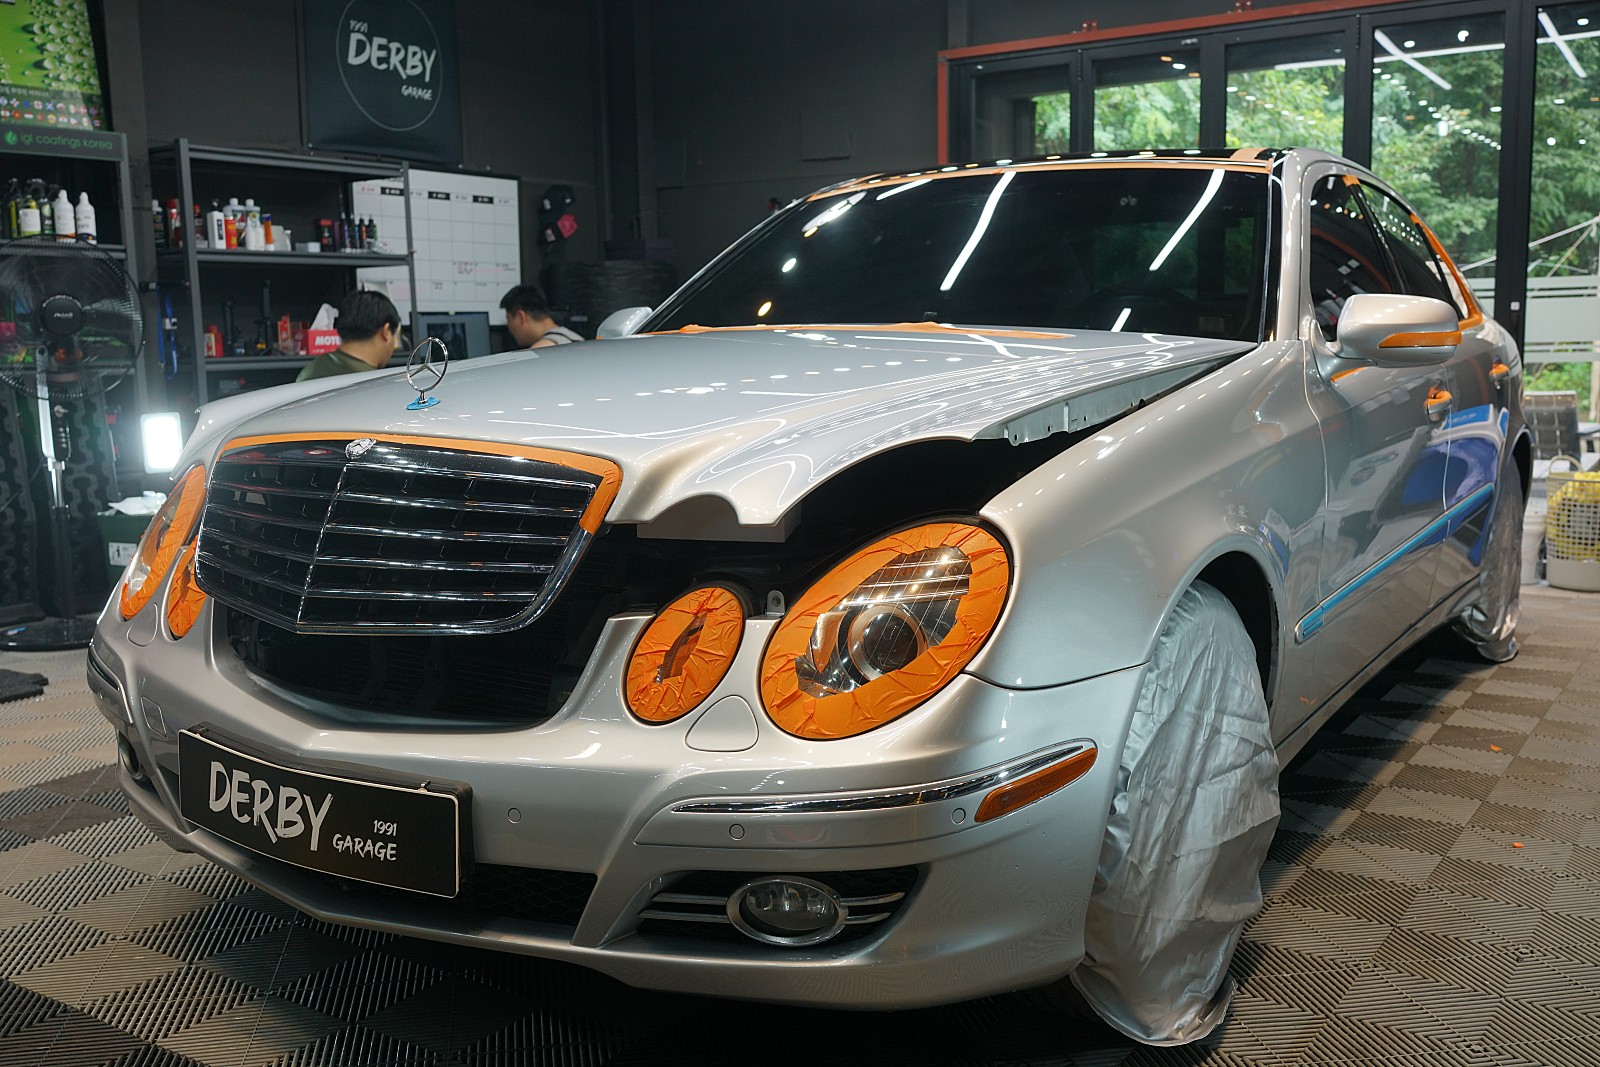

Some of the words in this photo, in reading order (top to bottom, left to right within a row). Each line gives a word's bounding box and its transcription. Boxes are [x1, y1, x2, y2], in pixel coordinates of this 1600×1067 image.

[347, 32, 437, 83] DERBY
[401, 84, 433, 101] GARAGE
[36, 134, 81, 149] coatings
[83, 137, 113, 150] korea
[315, 335, 342, 346] MOTU
[209, 760, 334, 851] DERBY
[373, 819, 397, 836] 1991
[332, 833, 397, 861] GARAGE
